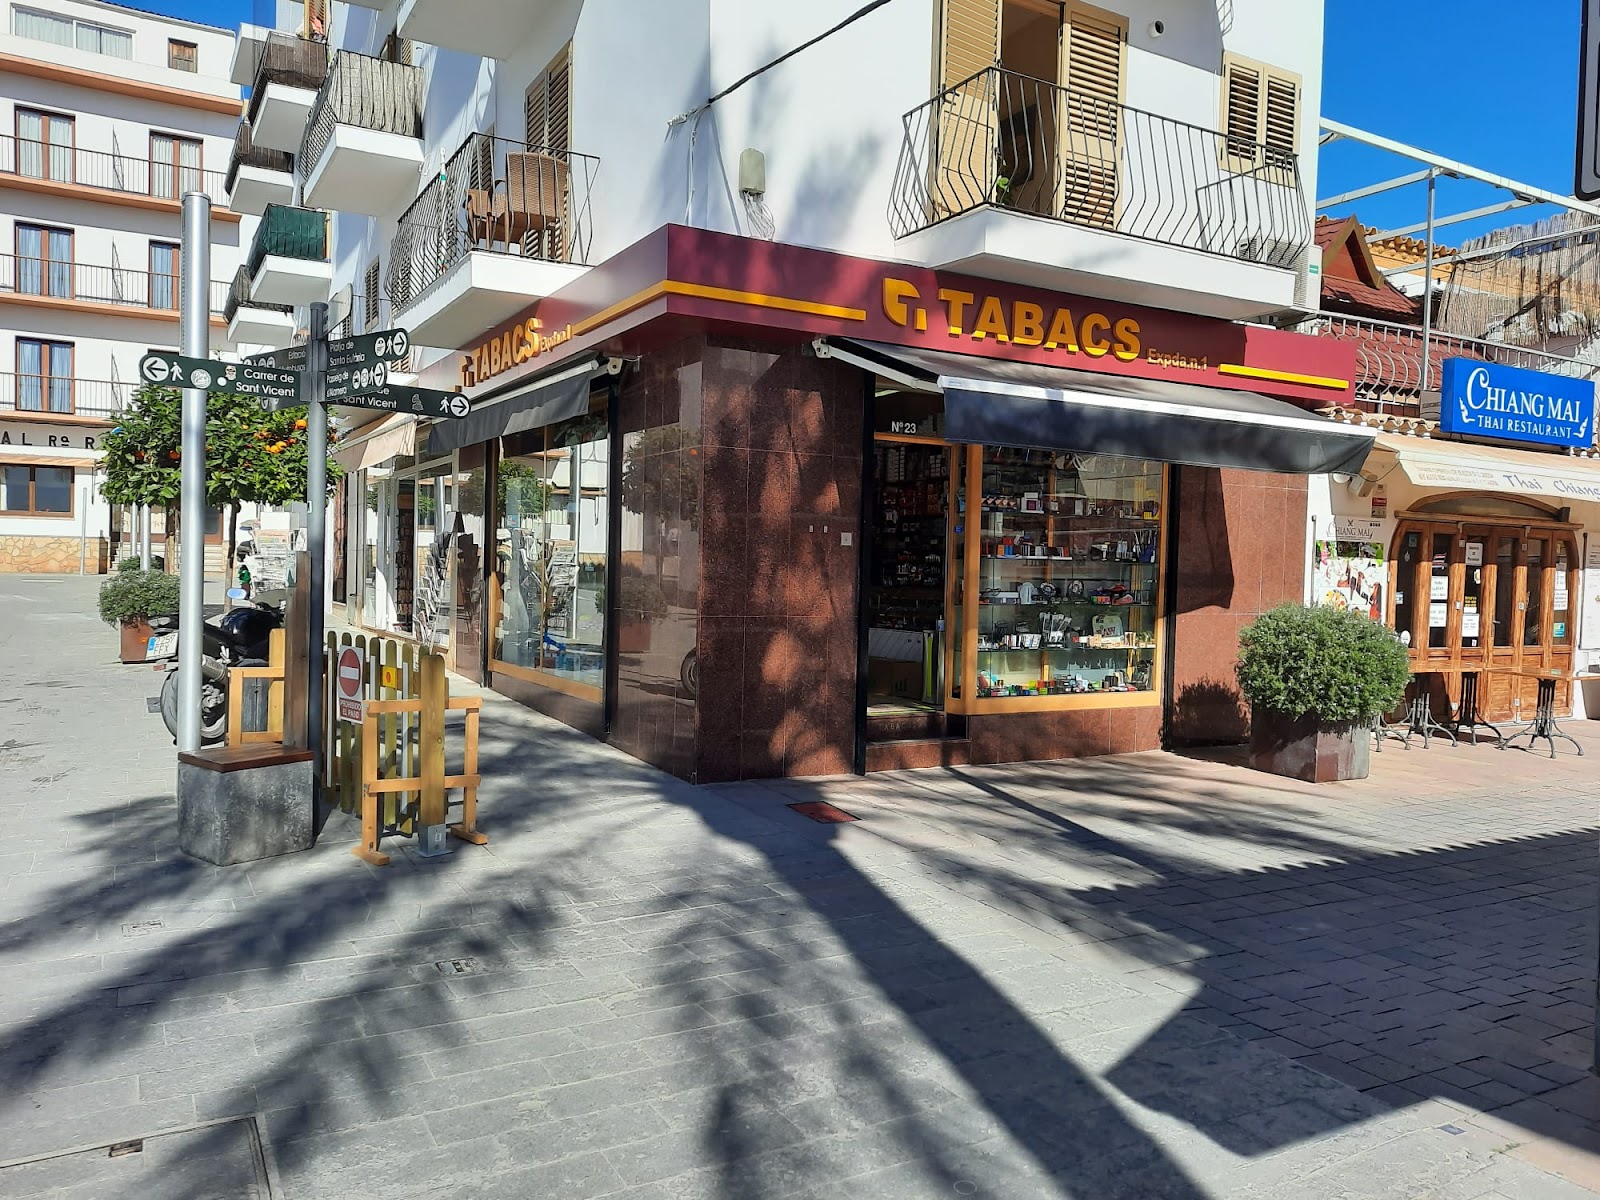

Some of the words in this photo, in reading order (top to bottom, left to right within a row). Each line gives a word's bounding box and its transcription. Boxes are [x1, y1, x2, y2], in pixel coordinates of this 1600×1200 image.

[938, 288, 1142, 362] TABACS
[329, 342, 345, 352] Platja
[346, 340, 354, 350] de
[472, 317, 544, 383] TABACS
[329, 355, 346, 366] Santa
[244, 368, 278, 382] Carrer
[280, 372, 295, 384] de
[236, 382, 259, 394] Sant
[262, 384, 295, 397] Vicent
[1466, 368, 1544, 418] CHIANG
[1547, 396, 1581, 423] MAI
[343, 396, 365, 405] Sant
[368, 397, 397, 408] Vicent
[1478, 414, 1503, 430] THAI
[1507, 418, 1572, 439] RESTAURANT
[1502, 474, 1543, 490] Thai
[1358, 528, 1371, 536] MAI
[340, 700, 362, 711] PROHIBIDO
[342, 708, 348, 716] EL
